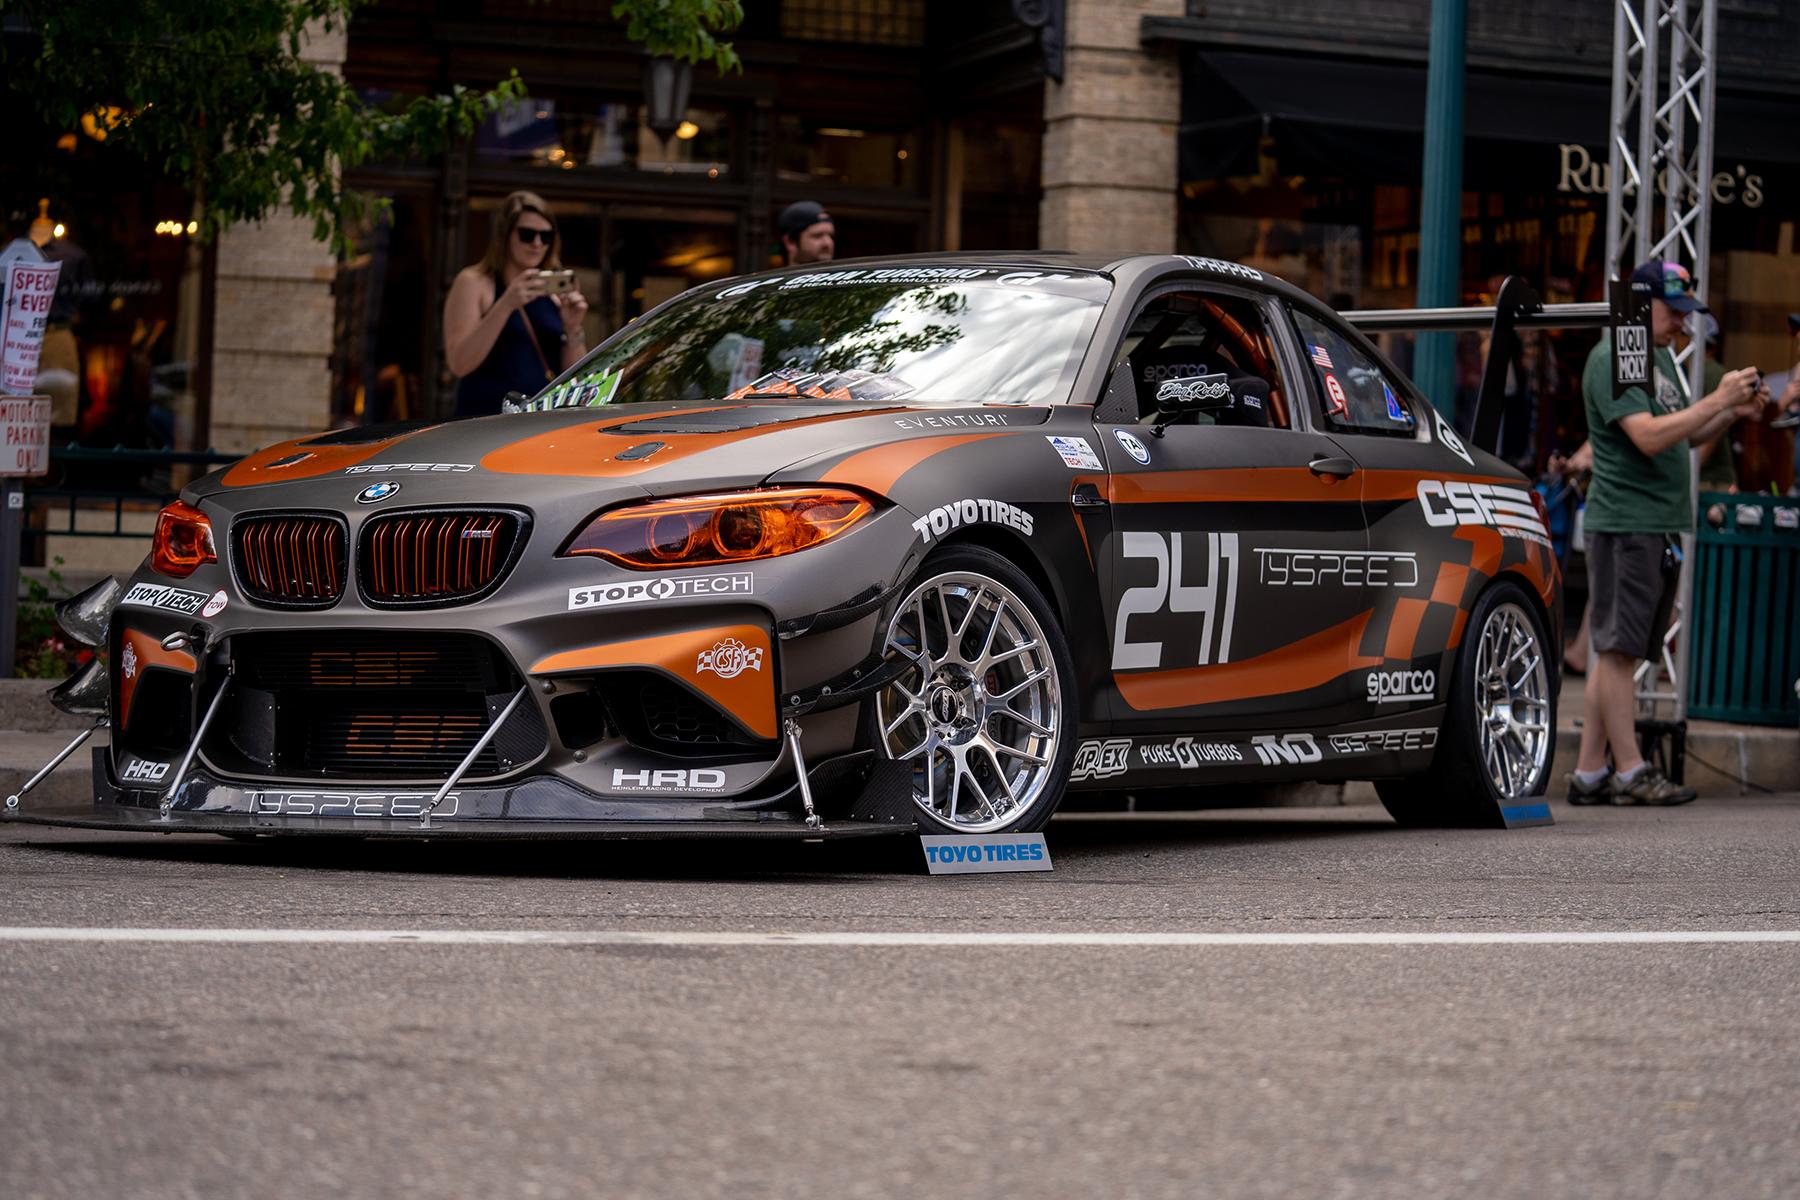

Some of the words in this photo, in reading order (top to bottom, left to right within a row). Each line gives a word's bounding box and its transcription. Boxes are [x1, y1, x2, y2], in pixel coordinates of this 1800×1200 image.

[778, 283, 801, 291] THE
[803, 280, 834, 288] REAL
[837, 278, 887, 286] DRIVING
[785, 270, 867, 285] GRAN
[863, 268, 988, 280] TURISMO
[1618, 329, 1648, 352] LIQUI
[1618, 355, 1648, 380] MOLY
[894, 414, 1008, 429] EVENTURI
[911, 499, 978, 544] TOYO
[977, 498, 1034, 537] TIRES
[1111, 531, 1239, 669] 241
[715, 648, 742, 669] CSF
[1367, 669, 1435, 699] sparco
[1071, 742, 1131, 774] APEX
[1140, 744, 1175, 764] PURE
[1195, 743, 1243, 762] TURBOS
[124, 760, 171, 779] HRD
[612, 768, 726, 788] HRD
[926, 846, 983, 864] TOYO
[983, 843, 1044, 862] TIRES
